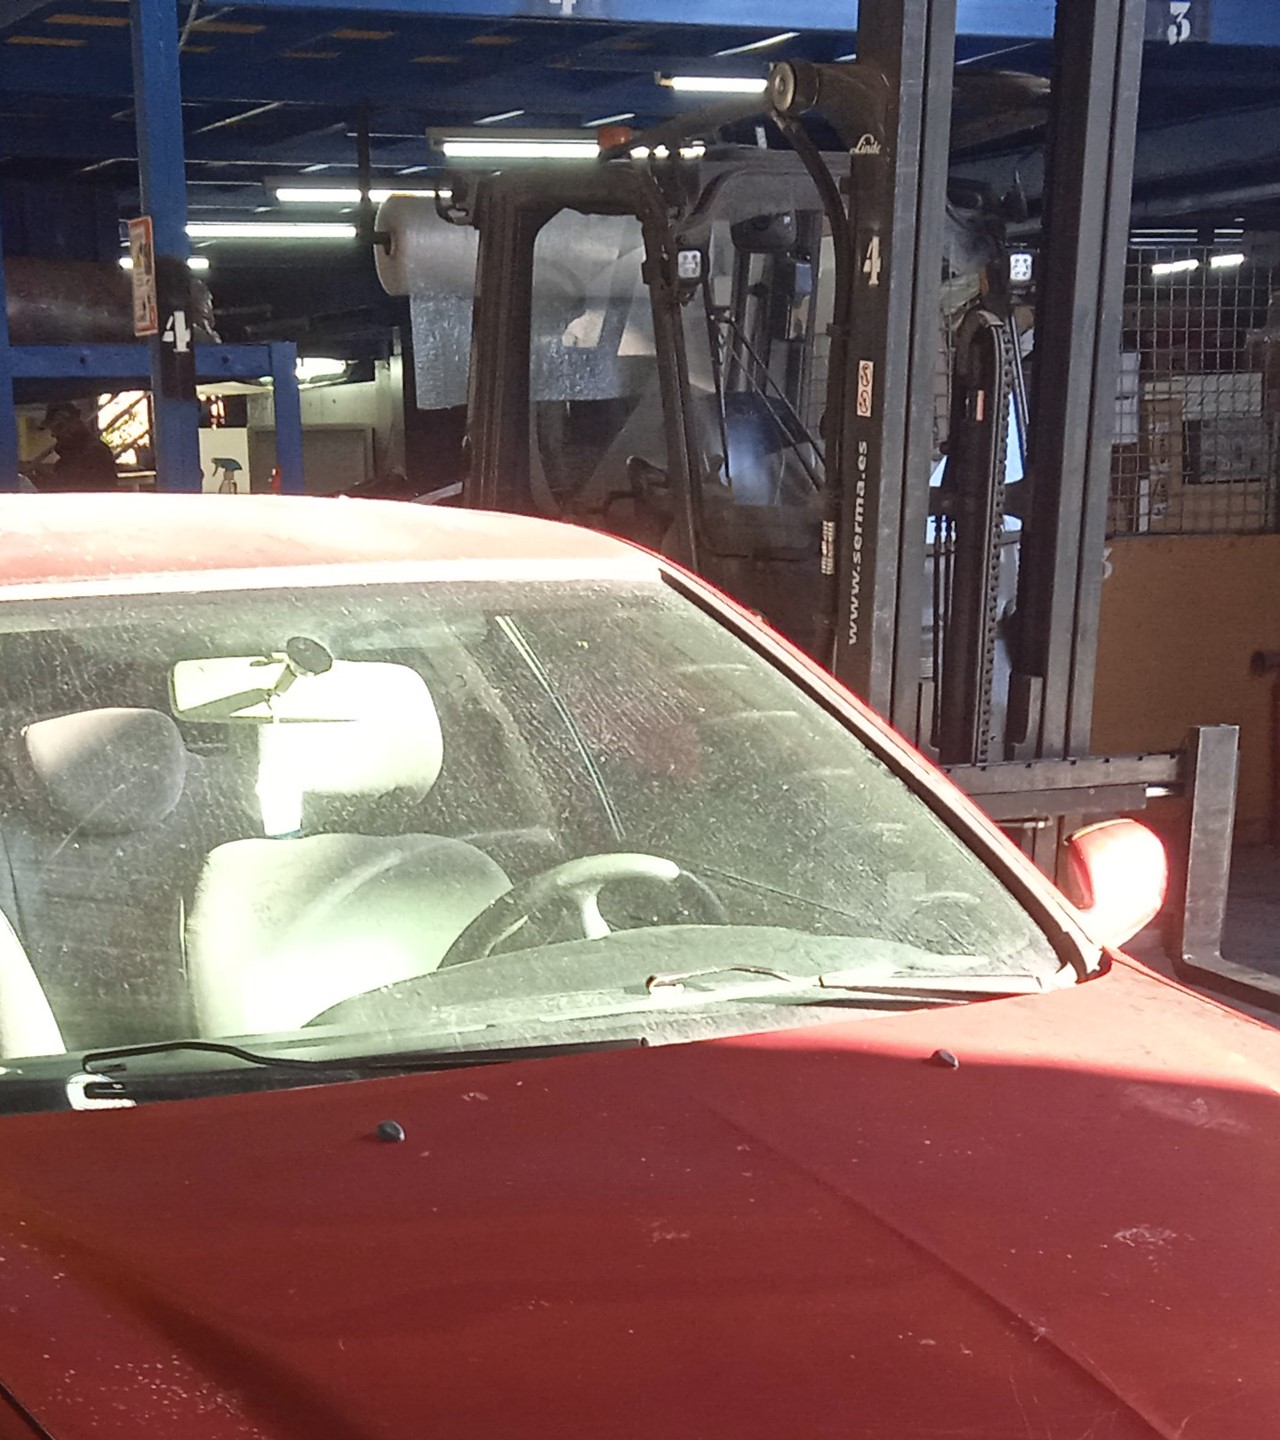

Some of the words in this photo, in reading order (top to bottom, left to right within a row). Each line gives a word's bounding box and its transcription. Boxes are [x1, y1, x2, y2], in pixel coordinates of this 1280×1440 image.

[1168, 1, 1191, 45] 3
[863, 236, 881, 285] 4
[162, 310, 191, 352] 4
[848, 440, 868, 645] www.serma.es
